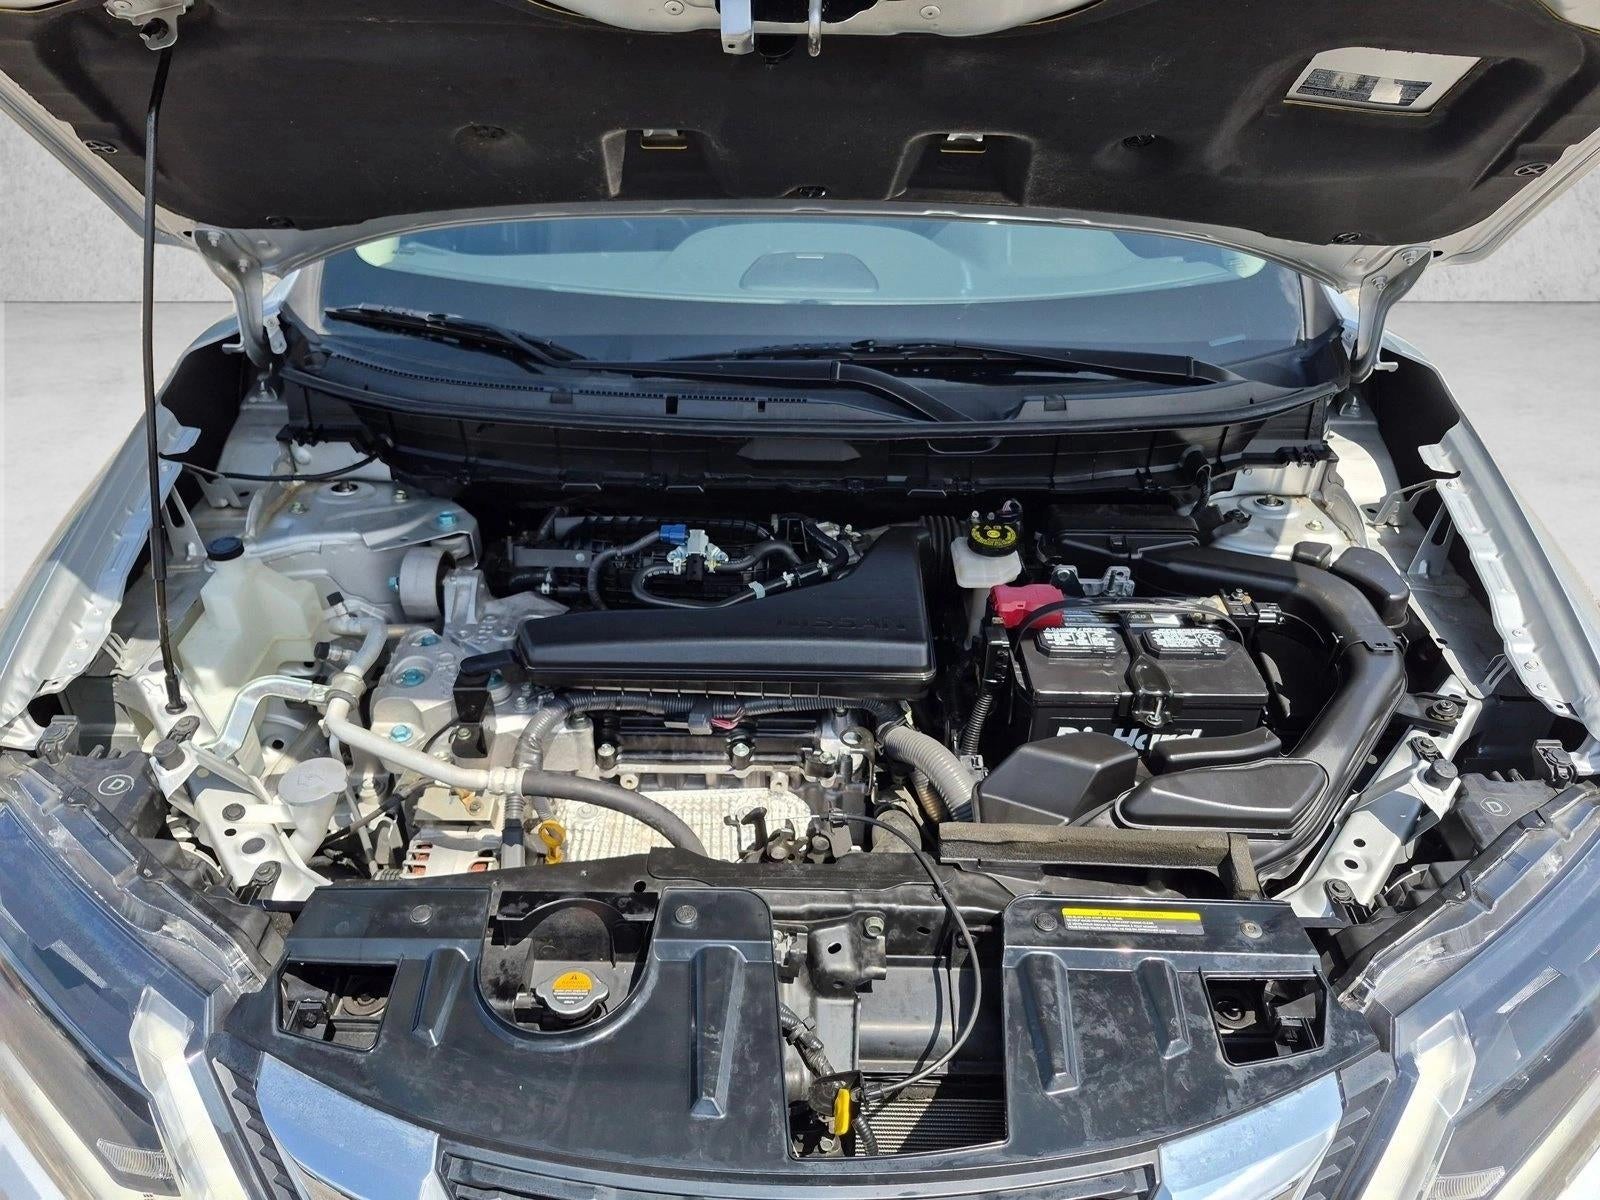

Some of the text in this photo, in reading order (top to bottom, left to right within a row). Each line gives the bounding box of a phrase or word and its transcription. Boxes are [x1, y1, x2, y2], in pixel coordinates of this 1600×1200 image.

[776, 615, 908, 632] NISSAN
[1056, 726, 1203, 750] DHad
[107, 778, 126, 790] D
[1485, 801, 1503, 812] D
